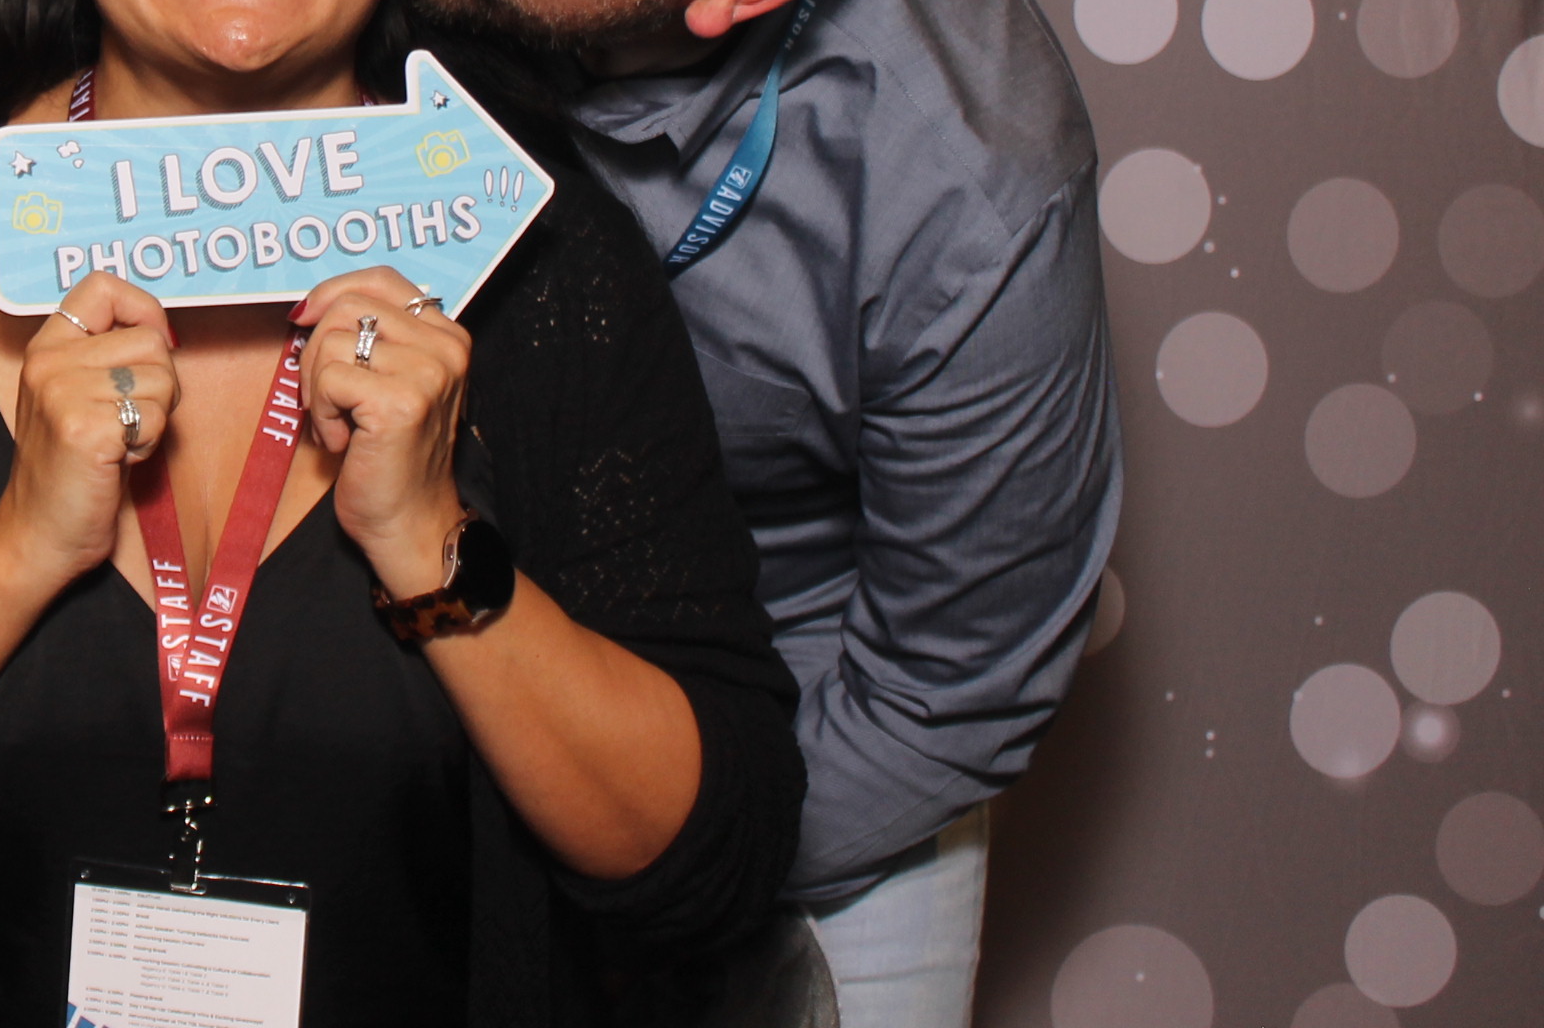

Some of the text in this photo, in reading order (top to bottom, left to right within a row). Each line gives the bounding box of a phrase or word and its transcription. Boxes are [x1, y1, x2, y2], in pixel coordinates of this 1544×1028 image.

[111, 130, 364, 222] I LOVE
[55, 195, 482, 291] PHOTOBOOTHS
[667, 185, 743, 265] ADVISOR
[152, 558, 191, 650] STAFF
[179, 613, 234, 708] STAFF
